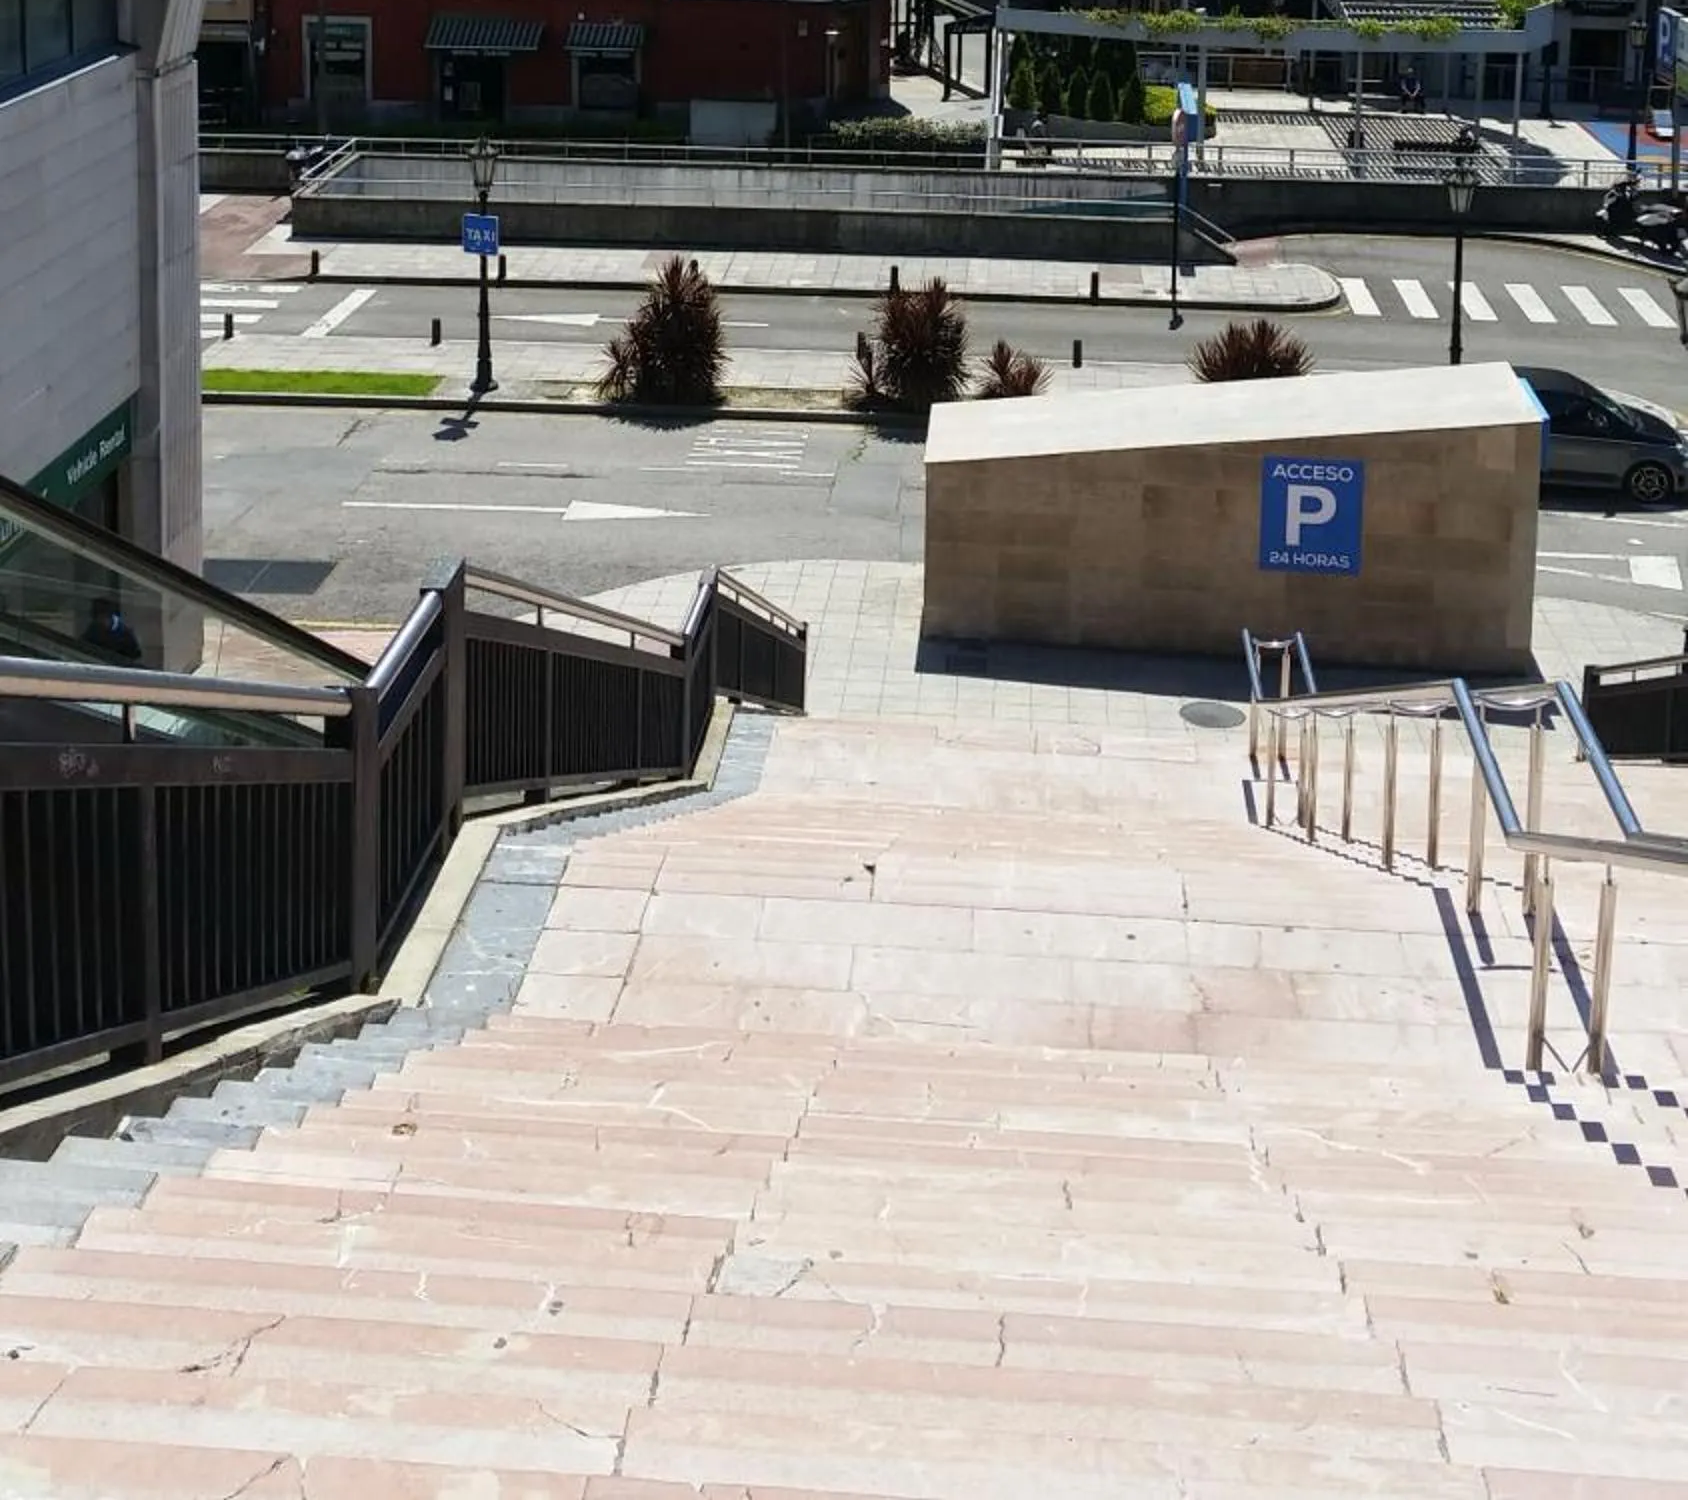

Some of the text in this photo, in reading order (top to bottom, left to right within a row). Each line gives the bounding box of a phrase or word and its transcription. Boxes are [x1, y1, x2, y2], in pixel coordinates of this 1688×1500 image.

[1656, 13, 1671, 59] P
[465, 228, 495, 242] TAXI
[66, 422, 126, 485] Vehicle Rental
[1272, 463, 1354, 482] ACCESO
[1286, 483, 1337, 546] P
[1269, 551, 1351, 569] 24 HORAS
